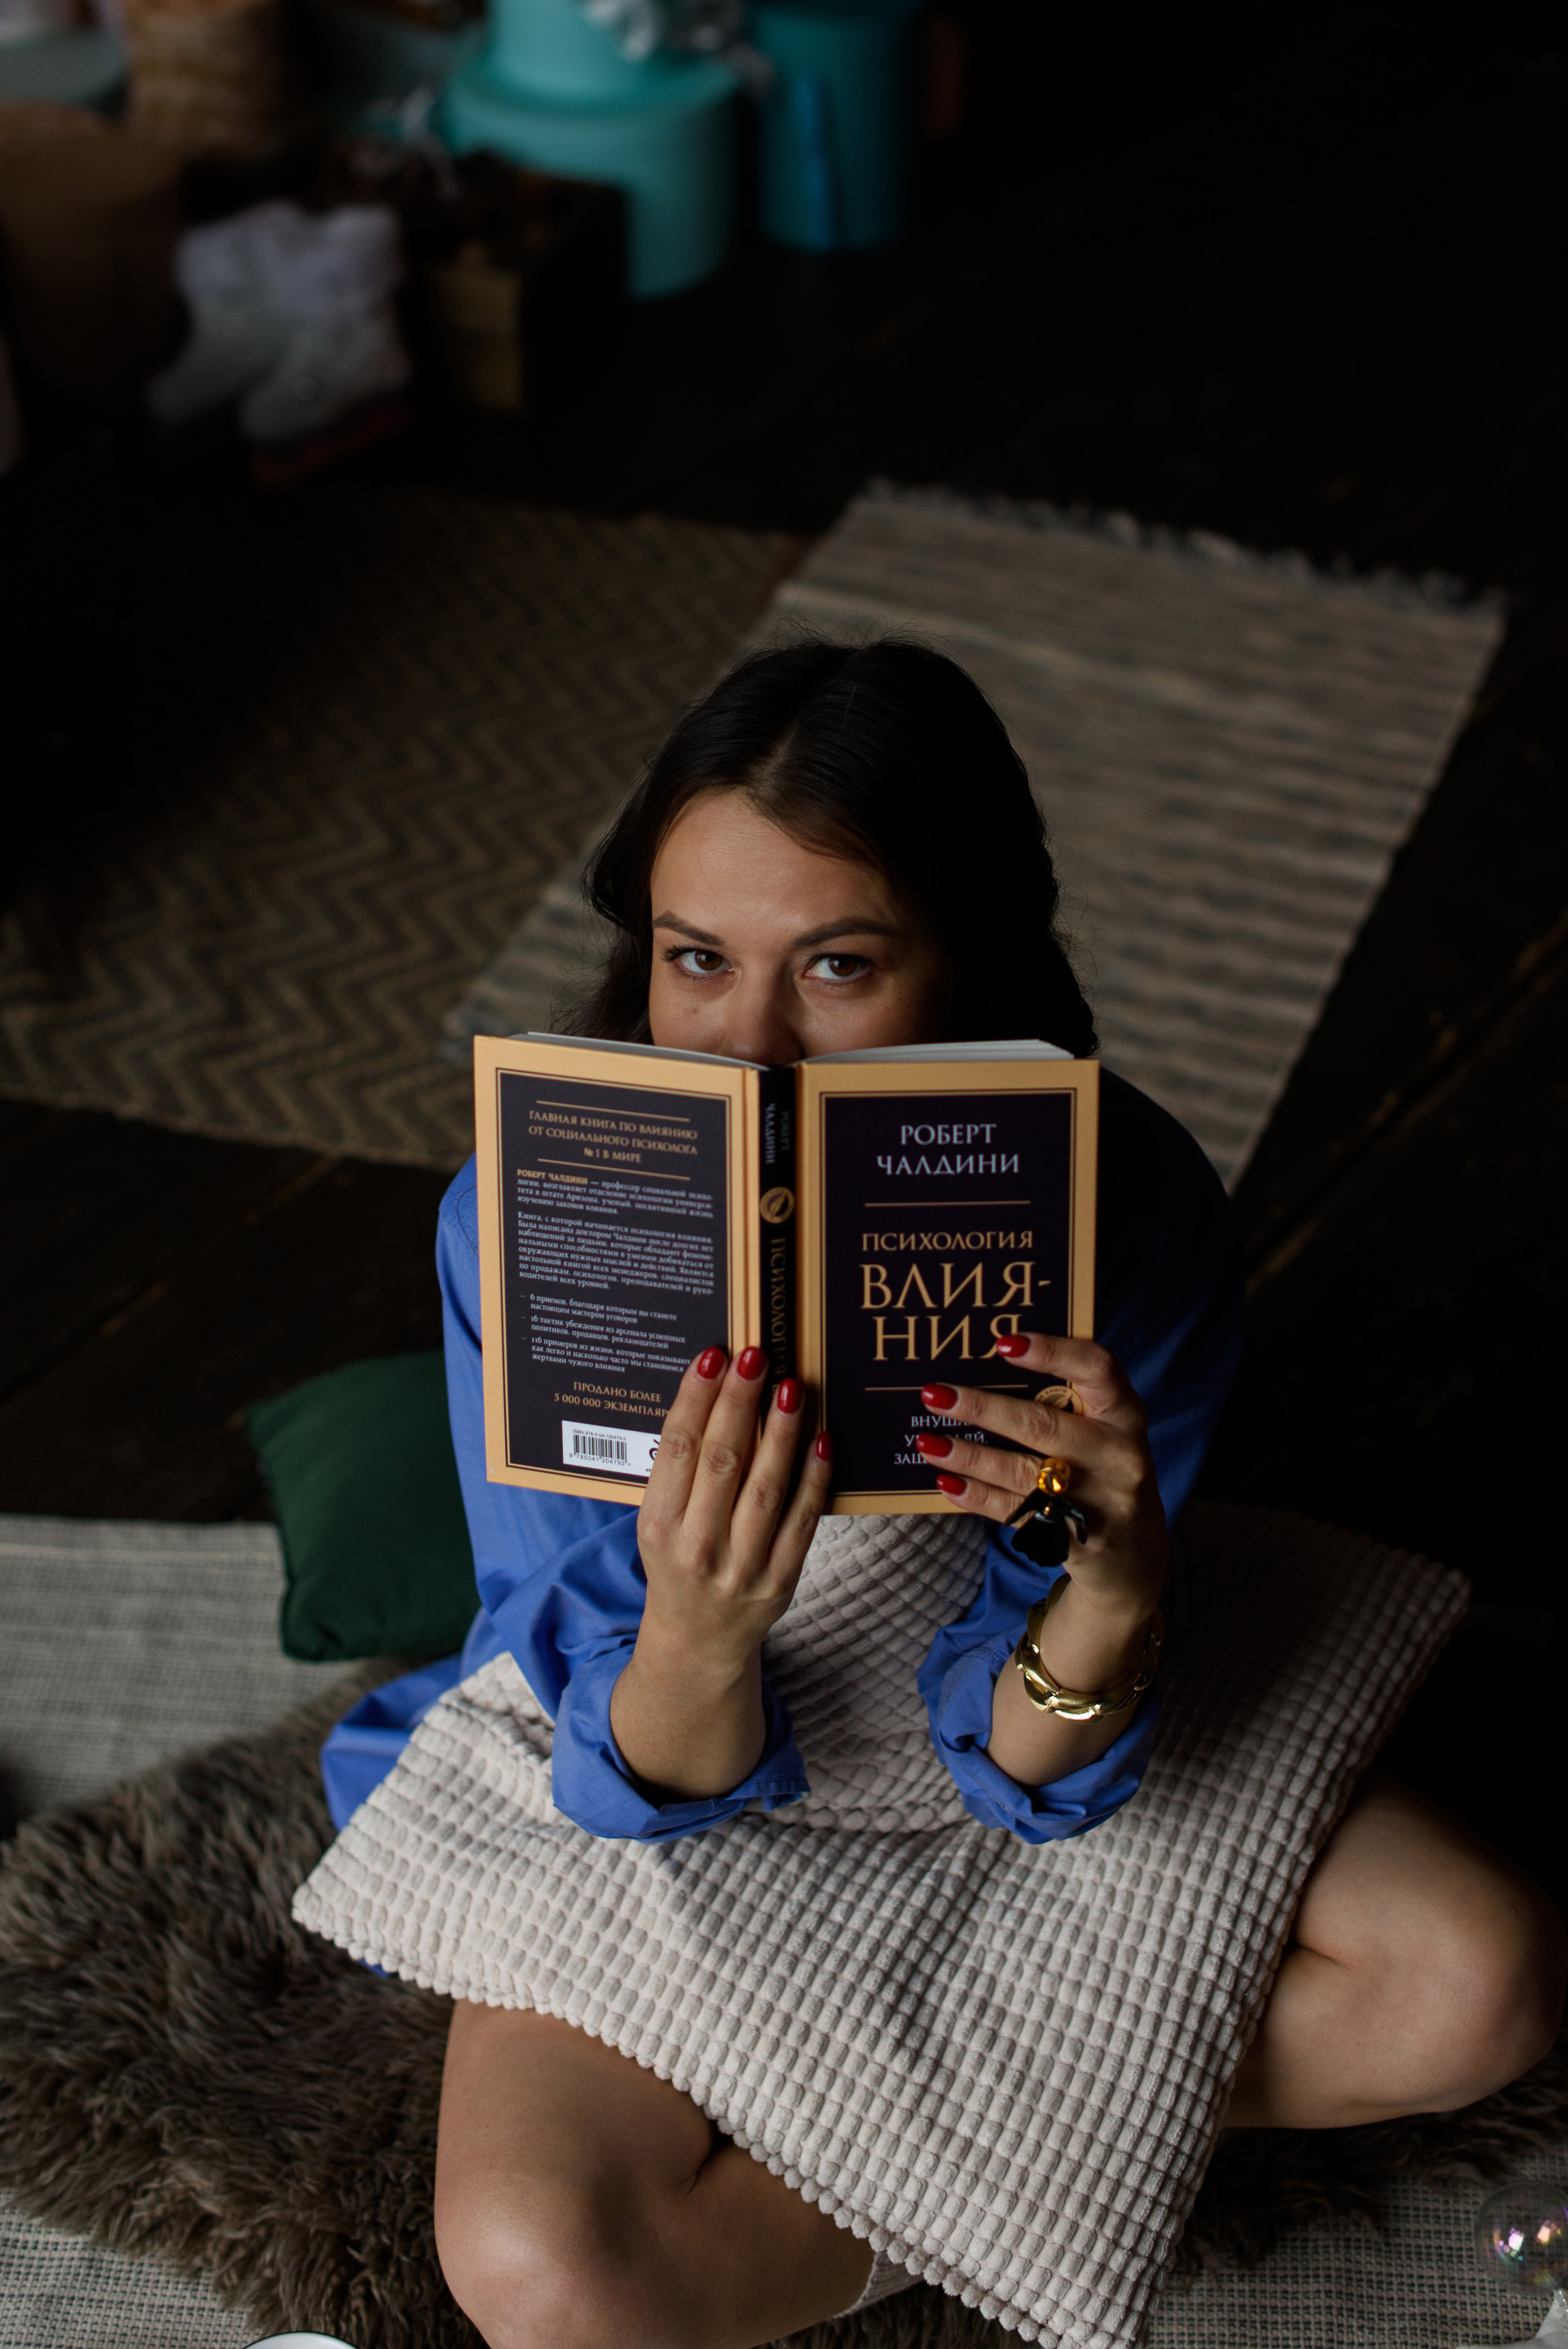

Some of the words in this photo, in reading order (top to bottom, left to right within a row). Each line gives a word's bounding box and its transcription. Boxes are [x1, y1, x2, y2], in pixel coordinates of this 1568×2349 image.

[529, 1110, 577, 1124] ГЛАВНАЯ
[580, 1117, 616, 1129] КНИГА
[619, 1122, 636, 1131] ПО
[639, 1125, 697, 1139] ВЛИЯНИЮ
[765, 1103, 776, 1164] ЧАЛДИНИ
[900, 1123, 997, 1145] РОБЕРТ
[528, 1125, 543, 1135] ОТ
[545, 1128, 629, 1145] СОЦИАЛЬНОГО
[632, 1138, 697, 1154] ПСИХОЛОГА
[603, 1149, 609, 1159] В
[612, 1152, 641, 1163] МИРЕ
[876, 1153, 1019, 1175] ЧАЛДИНИ
[517, 1169, 545, 1178] РОБЕРТ
[548, 1173, 587, 1184] ЧАЛДИНИ
[601, 1181, 639, 1193] профессор
[642, 1186, 685, 1197] социальной
[543, 1182, 586, 1193] возглавляет
[589, 1188, 627, 1197] отделение
[629, 1193, 673, 1204] психологии
[518, 1196, 554, 1205] изучению
[556, 1201, 584, 1209] законов
[635, 1203, 686, 1214] посвятивший
[518, 1220, 536, 1230] Была
[538, 1224, 573, 1233] написана
[575, 1229, 611, 1239] доктором
[613, 1232, 646, 1243] Чалдини
[551, 1217, 582, 1226] которой
[584, 1221, 628, 1232] начинается
[631, 1227, 675, 1239] психология
[518, 1229, 564, 1240] наблюдений
[610, 1242, 641, 1251] которые
[644, 1245, 680, 1256] обладают
[862, 1231, 1034, 1251] ПСИХОЛОГИЯ
[519, 1238, 557, 1248] нальными
[560, 1244, 618, 1256] способностями
[627, 1253, 656, 1261] умении
[658, 1256, 702, 1267] добиваться
[519, 1246, 568, 1257] окружающих
[571, 1253, 601, 1262] нужных
[603, 1258, 631, 1267] мыслей
[679, 1267, 713, 1277] Является
[519, 1255, 561, 1265] настольной
[662, 1274, 714, 1286] специалистов
[519, 1272, 557, 1281] водителей
[621, 1277, 682, 1290] преподавателей
[859, 1261, 1051, 1309] ВЛИЯ-
[530, 1303, 569, 1313] настоящим
[571, 1309, 604, 1319] мастером
[606, 1314, 637, 1324] уговоров
[570, 1299, 604, 1311] благодаря
[606, 1306, 636, 1314] которым
[650, 1311, 677, 1320] станете
[566, 1319, 603, 1331] убеждения
[616, 1328, 647, 1337] арсенала
[649, 1333, 685, 1343] успешных
[612, 1336, 668, 1348] рекламодателей
[872, 1314, 1022, 1360] НИЯ
[544, 1339, 577, 1349] примеров
[616, 1349, 645, 1359] которые
[532, 1354, 566, 1363] жертвами
[568, 1359, 593, 1367] чужого
[595, 1363, 624, 1371] влияния
[573, 1351, 608, 1361] насколько
[643, 1362, 683, 1371] становимся
[573, 1381, 627, 1397] ПРОДАНО
[630, 1390, 660, 1402] БОЛЕЕ
[554, 1392, 559, 1401] 5
[562, 1394, 579, 1404] 000
[582, 1397, 600, 1407] 000
[604, 1400, 668, 1418] ЭКЗЕМПЛЯР
